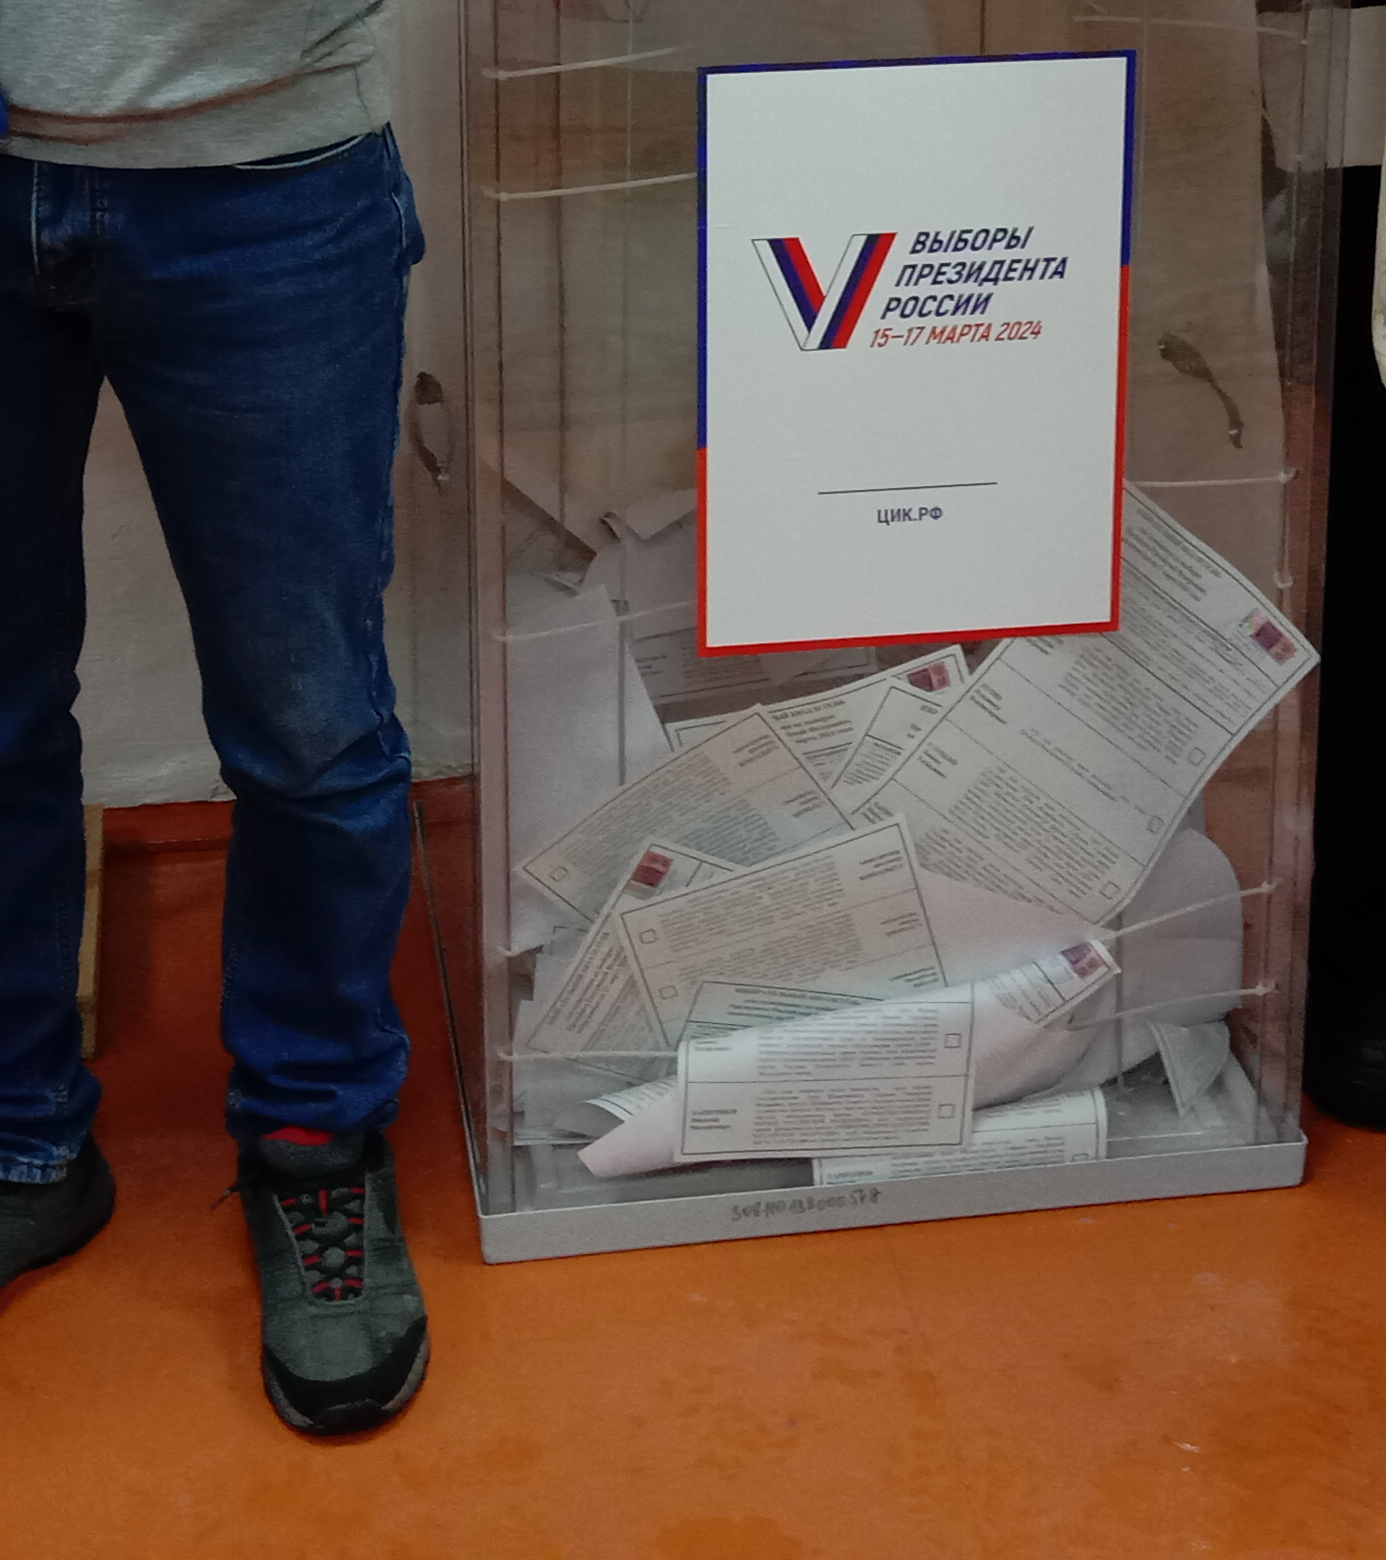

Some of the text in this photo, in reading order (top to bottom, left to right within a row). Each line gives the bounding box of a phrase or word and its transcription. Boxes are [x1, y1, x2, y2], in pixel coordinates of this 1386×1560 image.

[909, 226, 1035, 255] ВЫБОРЫ
[894, 256, 1069, 288] ПРЕЗИДЕНТА
[880, 292, 994, 320] РОССИИ
[925, 322, 994, 346] МАРТА
[994, 320, 1044, 343] 2024
[876, 505, 944, 527] ЦИК.РФ
